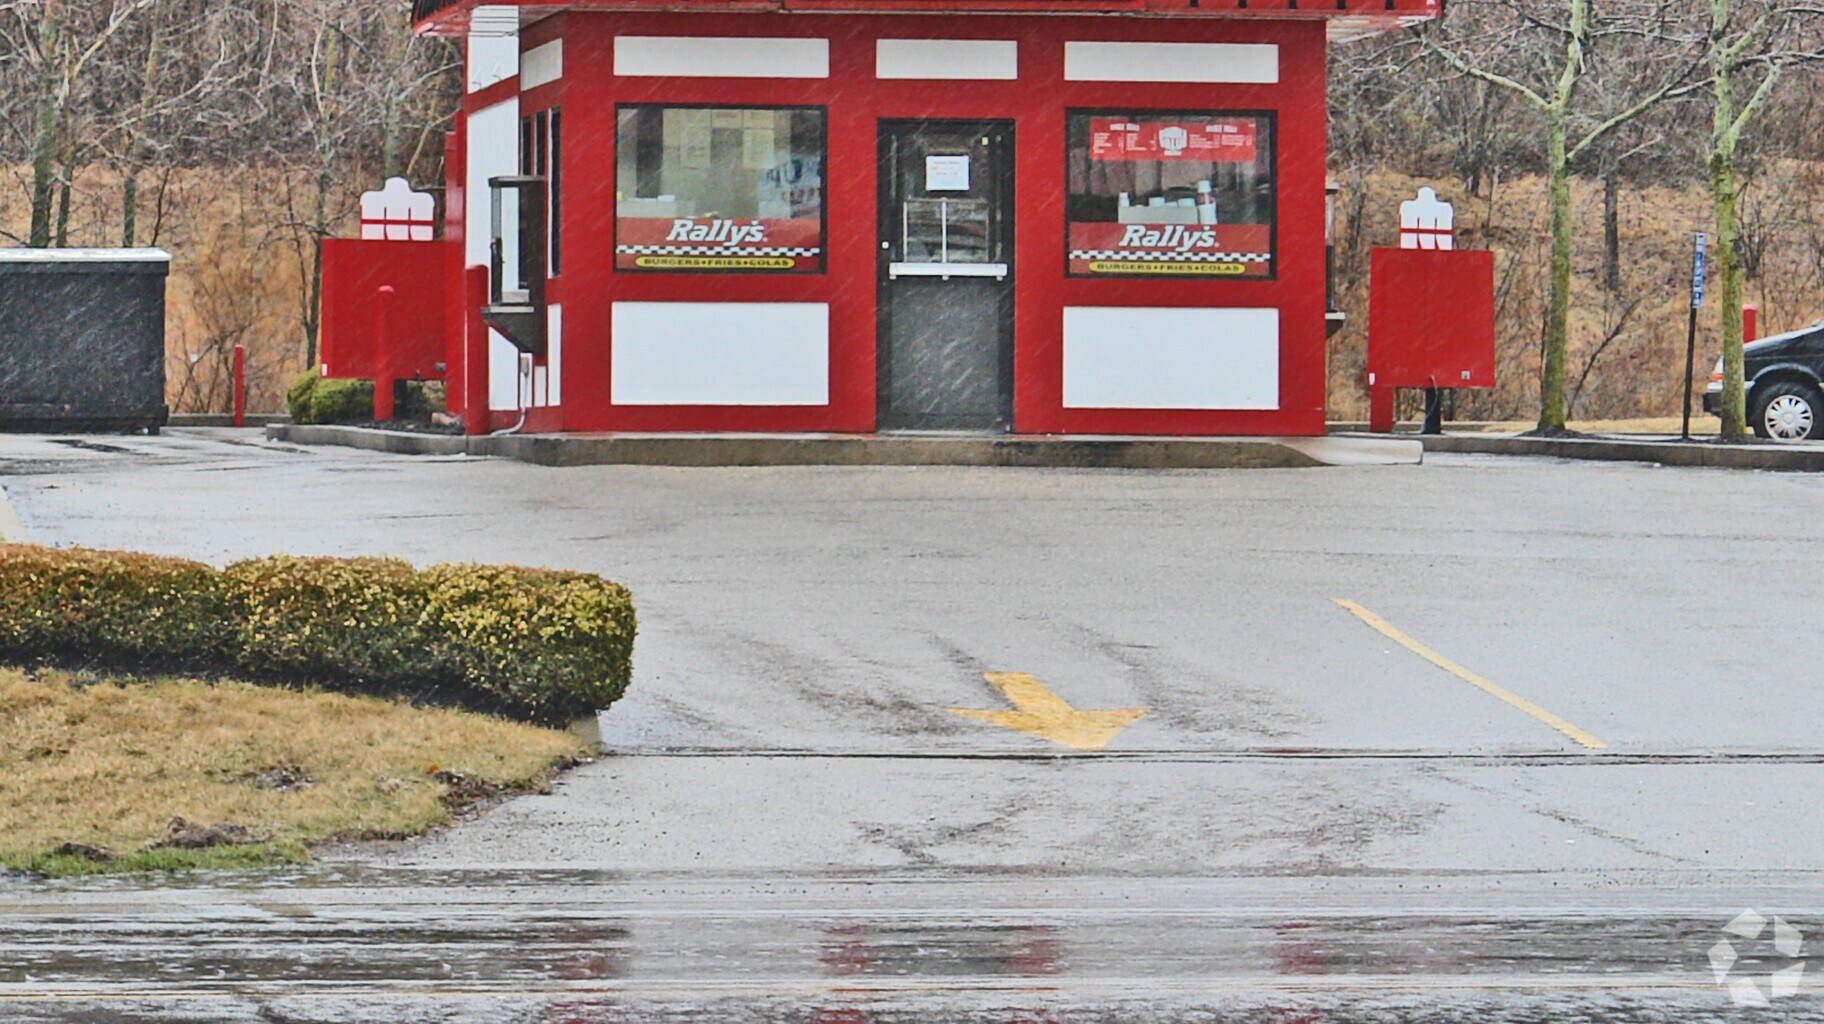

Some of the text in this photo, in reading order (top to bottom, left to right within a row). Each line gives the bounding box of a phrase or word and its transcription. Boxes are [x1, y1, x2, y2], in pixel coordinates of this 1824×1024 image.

[665, 219, 766, 247] Rally's
[1118, 224, 1217, 252] Rally's
[643, 258, 789, 267] BURGERS FRIES COLAS
[1096, 263, 1240, 272] BURGERS FRIES COLAS
